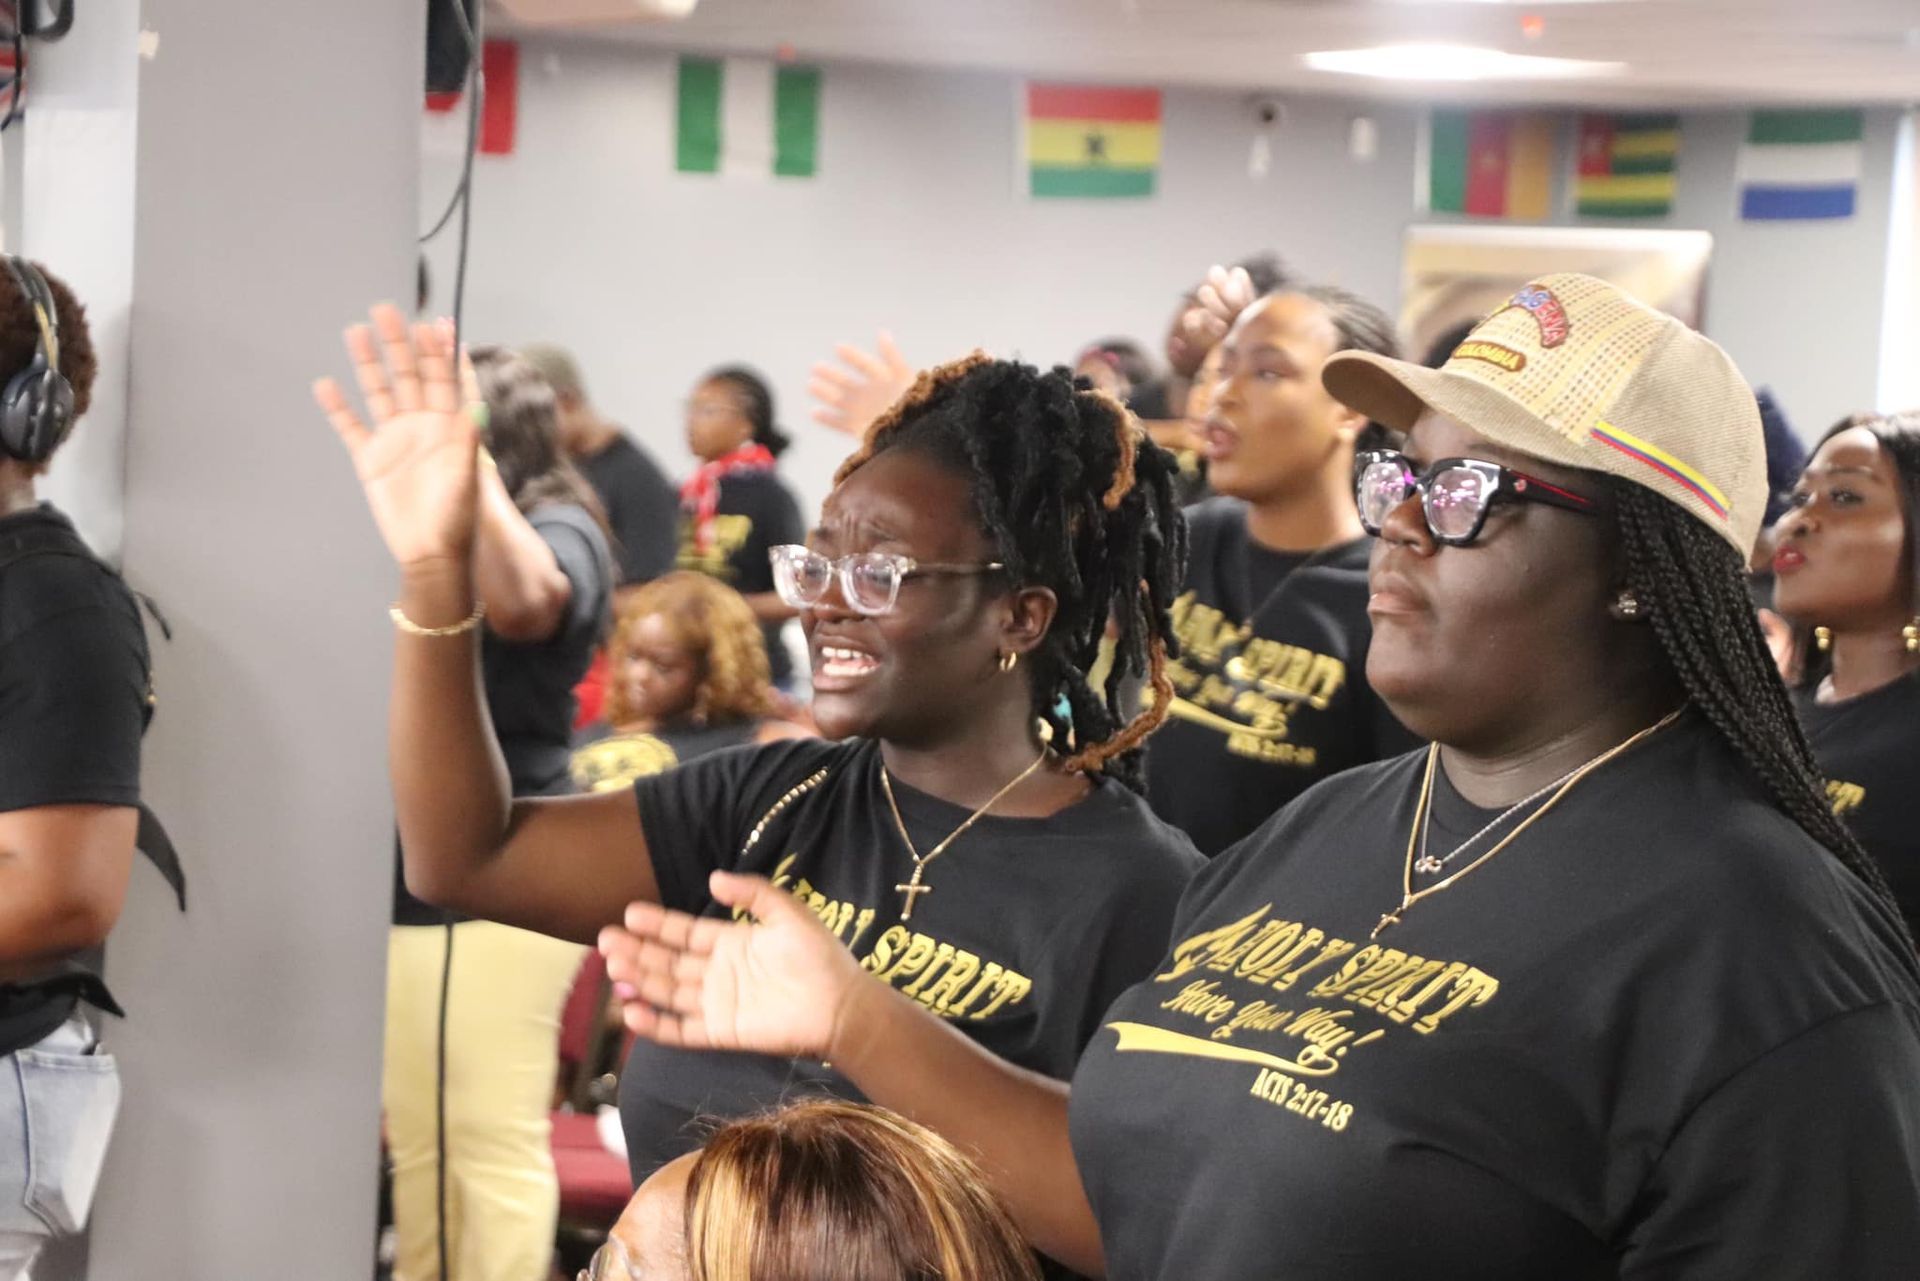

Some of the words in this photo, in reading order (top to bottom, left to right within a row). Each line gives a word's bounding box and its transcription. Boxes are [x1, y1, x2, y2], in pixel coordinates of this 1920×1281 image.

[860, 925, 1033, 1019] SPIRIT
[1306, 943, 1500, 1035] SPIRIT
[1160, 979, 1235, 1022] Have
[1283, 1007, 1385, 1068] Way!
[1250, 1067, 1296, 1106] ACTS
[1285, 1083, 1354, 1132] 2:17-18
